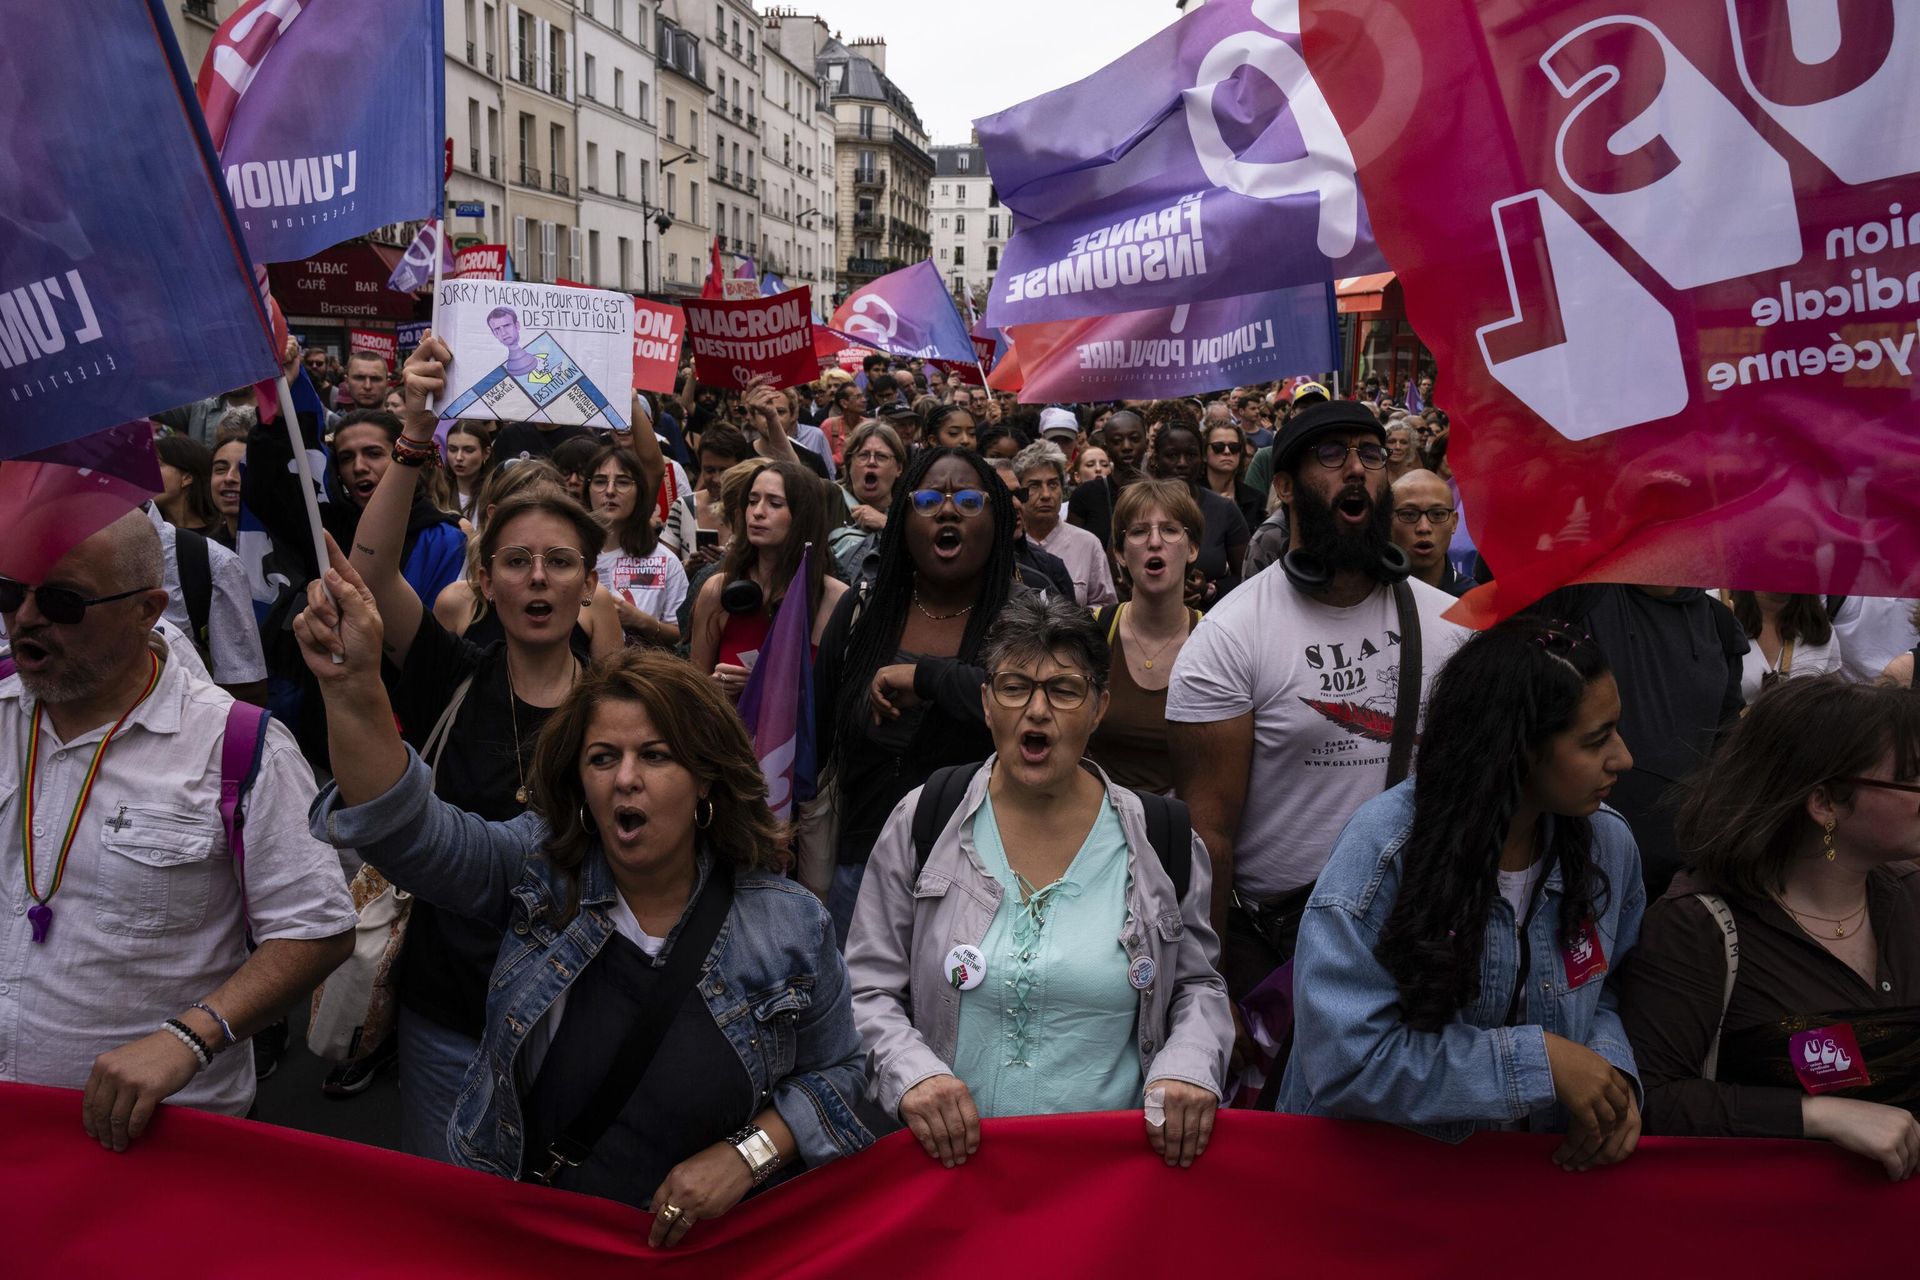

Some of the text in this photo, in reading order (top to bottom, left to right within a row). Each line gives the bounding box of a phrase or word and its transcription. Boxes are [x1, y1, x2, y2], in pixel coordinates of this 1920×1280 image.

[306, 261, 348, 274] TABAC
[297, 278, 378, 292] CAFÉ BAR
[320, 302, 378, 315] Brasserie
[545, 291, 572, 309] POUR
[592, 297, 624, 313] C'EST
[689, 300, 807, 337] MACRON,
[398, 331, 414, 344] 60
[1320, 667, 1367, 692] 2022
[1325, 739, 1355, 748] PARIS
[1337, 744, 1359, 753] MAI
[953, 951, 982, 972] PALESTINE
[963, 949, 978, 962] FREE
[1804, 1039, 1851, 1072] USL
